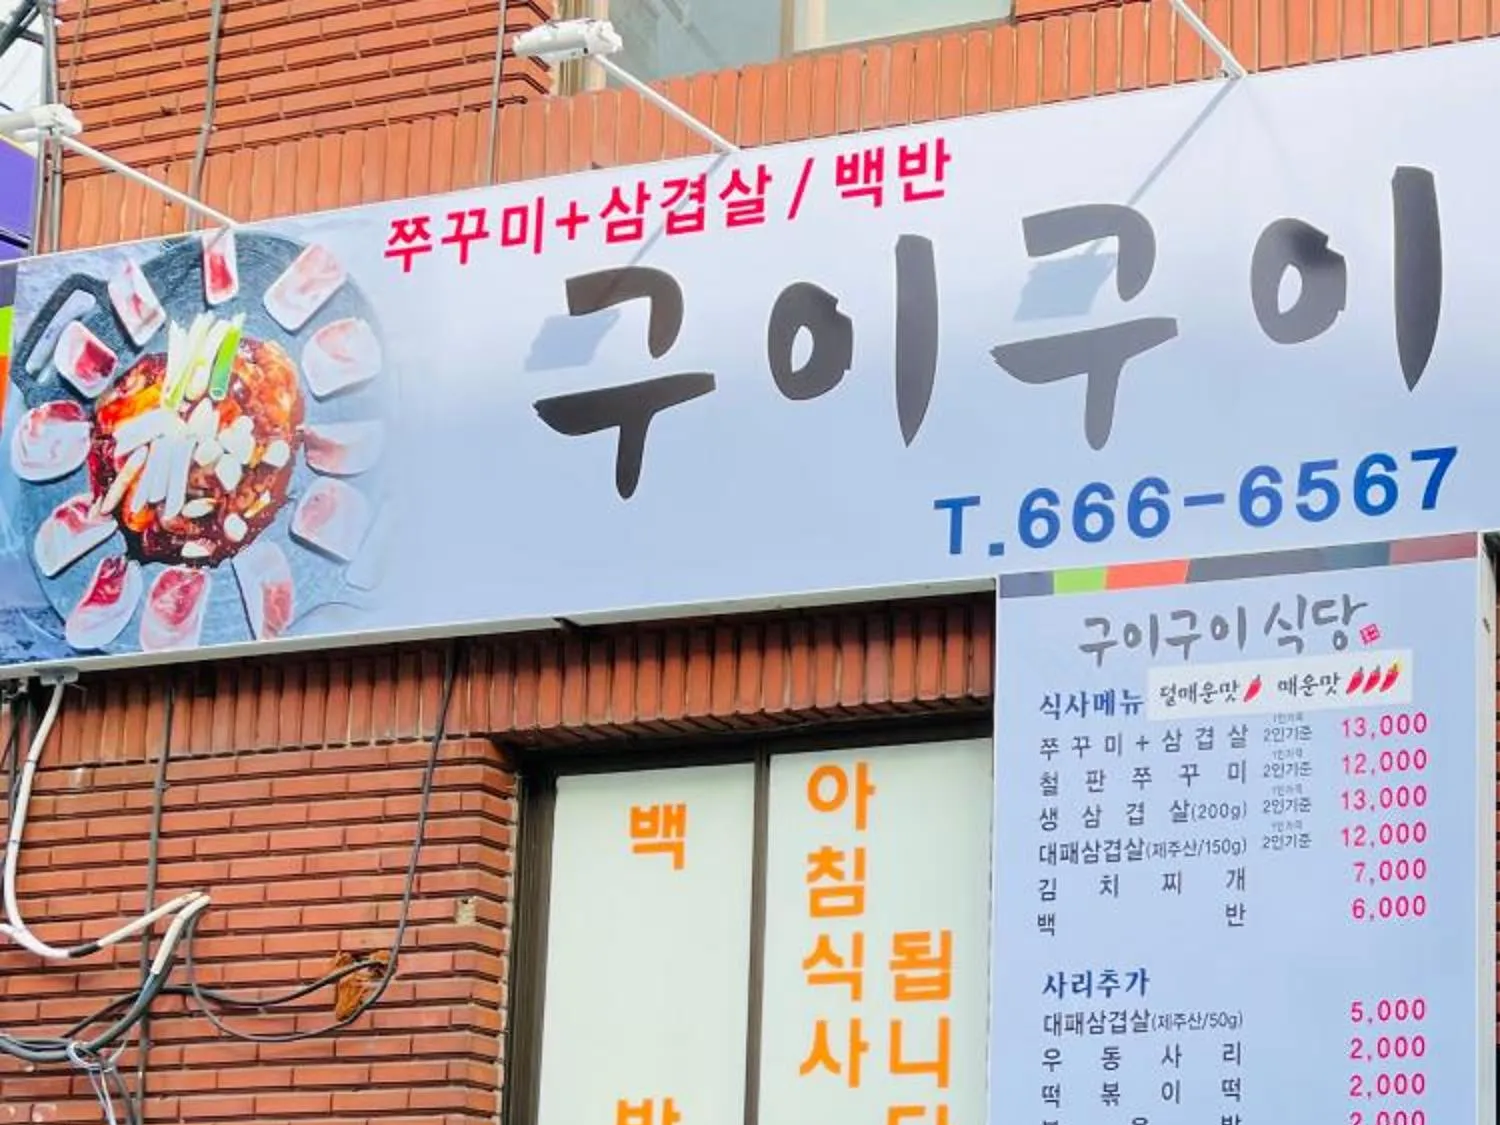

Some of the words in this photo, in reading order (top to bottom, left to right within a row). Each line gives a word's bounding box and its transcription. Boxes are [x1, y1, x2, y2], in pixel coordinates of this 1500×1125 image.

[384, 164, 772, 273] 쭈꾸미+삼겹살
[835, 138, 952, 209] 백반
[535, 166, 1441, 500] 구이구이
[934, 446, 1459, 558] T.666-6567
[1078, 605, 1248, 667] 구이구이
[1264, 594, 1369, 654] 식당
[1039, 688, 1145, 720] 식사메뉴
[1159, 680, 1240, 708] 덜매운맛
[1277, 671, 1341, 697] 매운맛
[1039, 724, 1249, 760] 쭈꾸미+삼겹살
[1263, 725, 1313, 743] 2인기준
[1341, 712, 1428, 740] 13,000
[1039, 760, 1247, 797] 철판쭈꾸미
[1263, 761, 1312, 779] 2인기준
[1342, 748, 1428, 776] 12,000
[1039, 799, 1247, 832] 생삼겹살(200g)
[1263, 797, 1312, 815] 2인기준
[1341, 785, 1428, 812] 13,000
[1039, 836, 1247, 865] 대패삼겹살(제주산/150g)
[1263, 833, 1313, 851] 2인기준
[1341, 821, 1428, 848] 12,000
[1038, 867, 1246, 901] 김치찌개
[1353, 858, 1428, 885] 7,000
[799, 761, 876, 1089] 아침식사
[1351, 894, 1427, 921] 6,000
[1042, 967, 1151, 999] 사리추가
[1043, 1009, 1244, 1036] 대패삼겹살(제주산/50g)
[1350, 998, 1426, 1025] 5,000
[1041, 1041, 1242, 1071] 우동사리
[1350, 1036, 1426, 1063] 2,000
[1041, 1076, 1242, 1108] 떡볶이떡
[1350, 1073, 1426, 1100] 2,000
